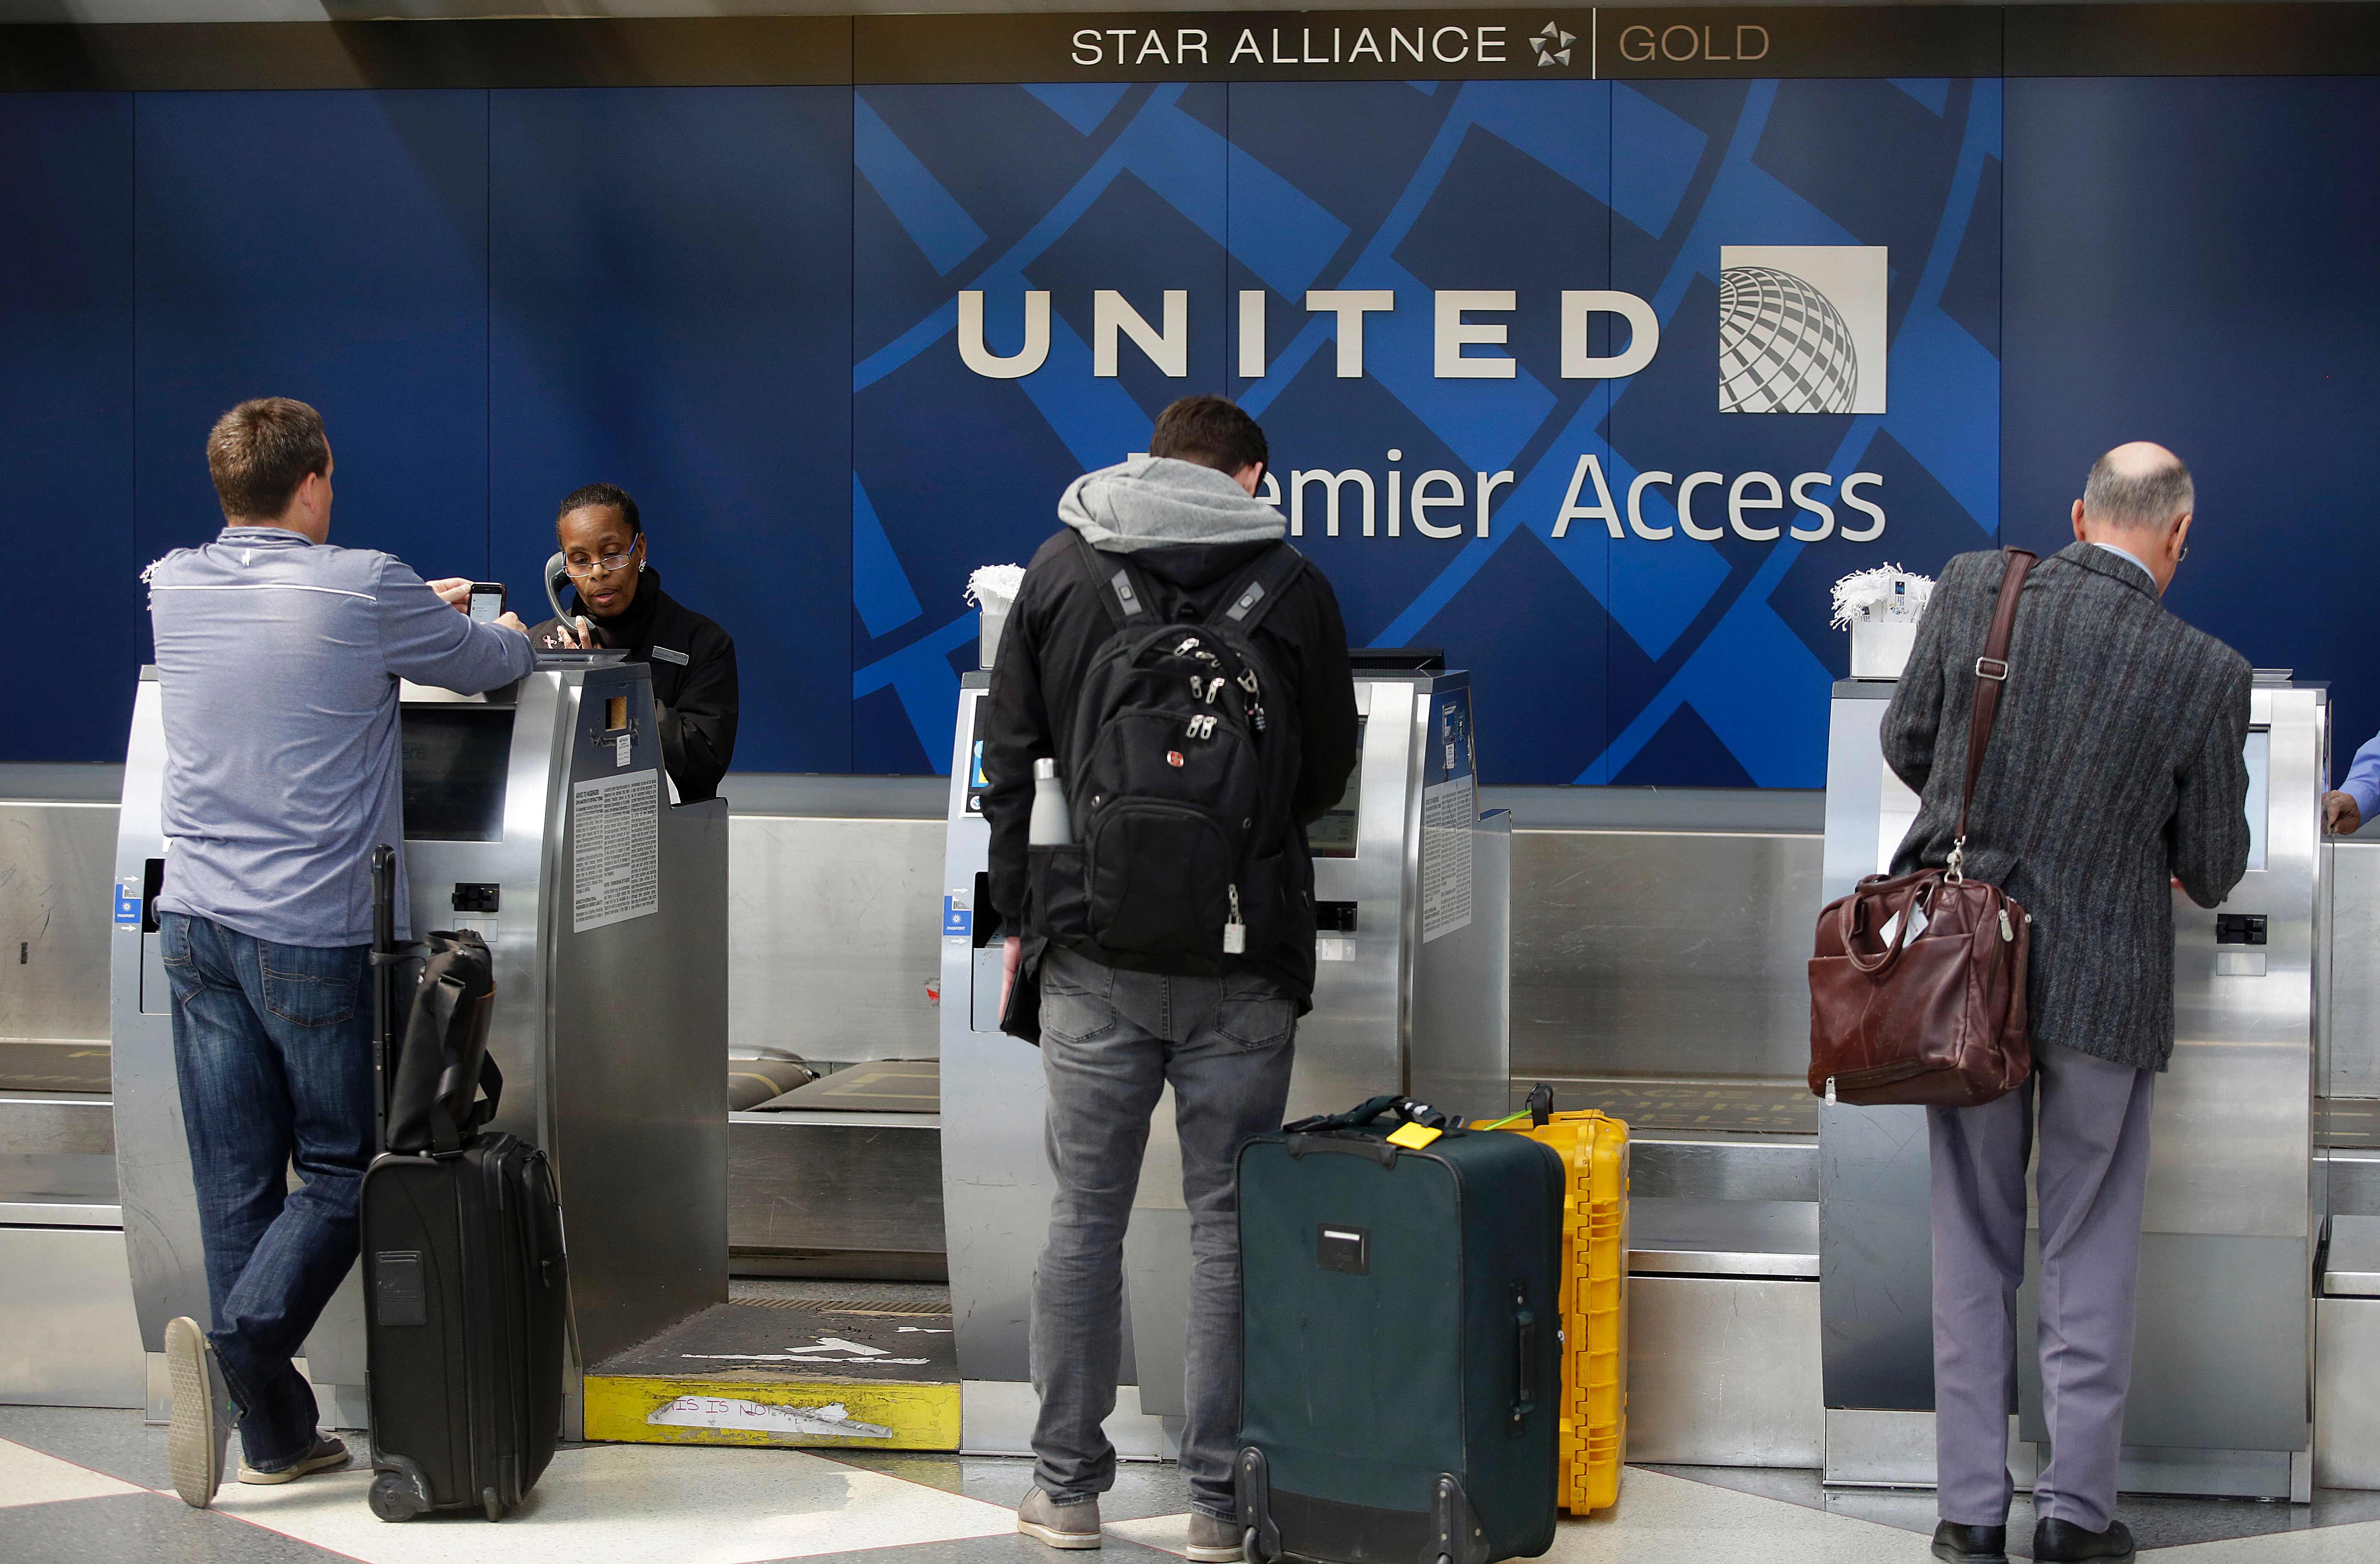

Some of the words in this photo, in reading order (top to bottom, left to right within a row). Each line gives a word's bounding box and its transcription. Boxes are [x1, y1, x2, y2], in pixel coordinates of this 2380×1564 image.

[1071, 29, 1208, 65] STAR
[1229, 26, 1507, 64] ALLIANCE
[1619, 25, 1770, 62] GOLD
[957, 290, 1660, 379] UNITED
[1254, 448, 1515, 539] mier
[1550, 454, 1886, 542] Access
[671, 1398, 699, 1410] IS
[706, 1400, 729, 1413] IS
